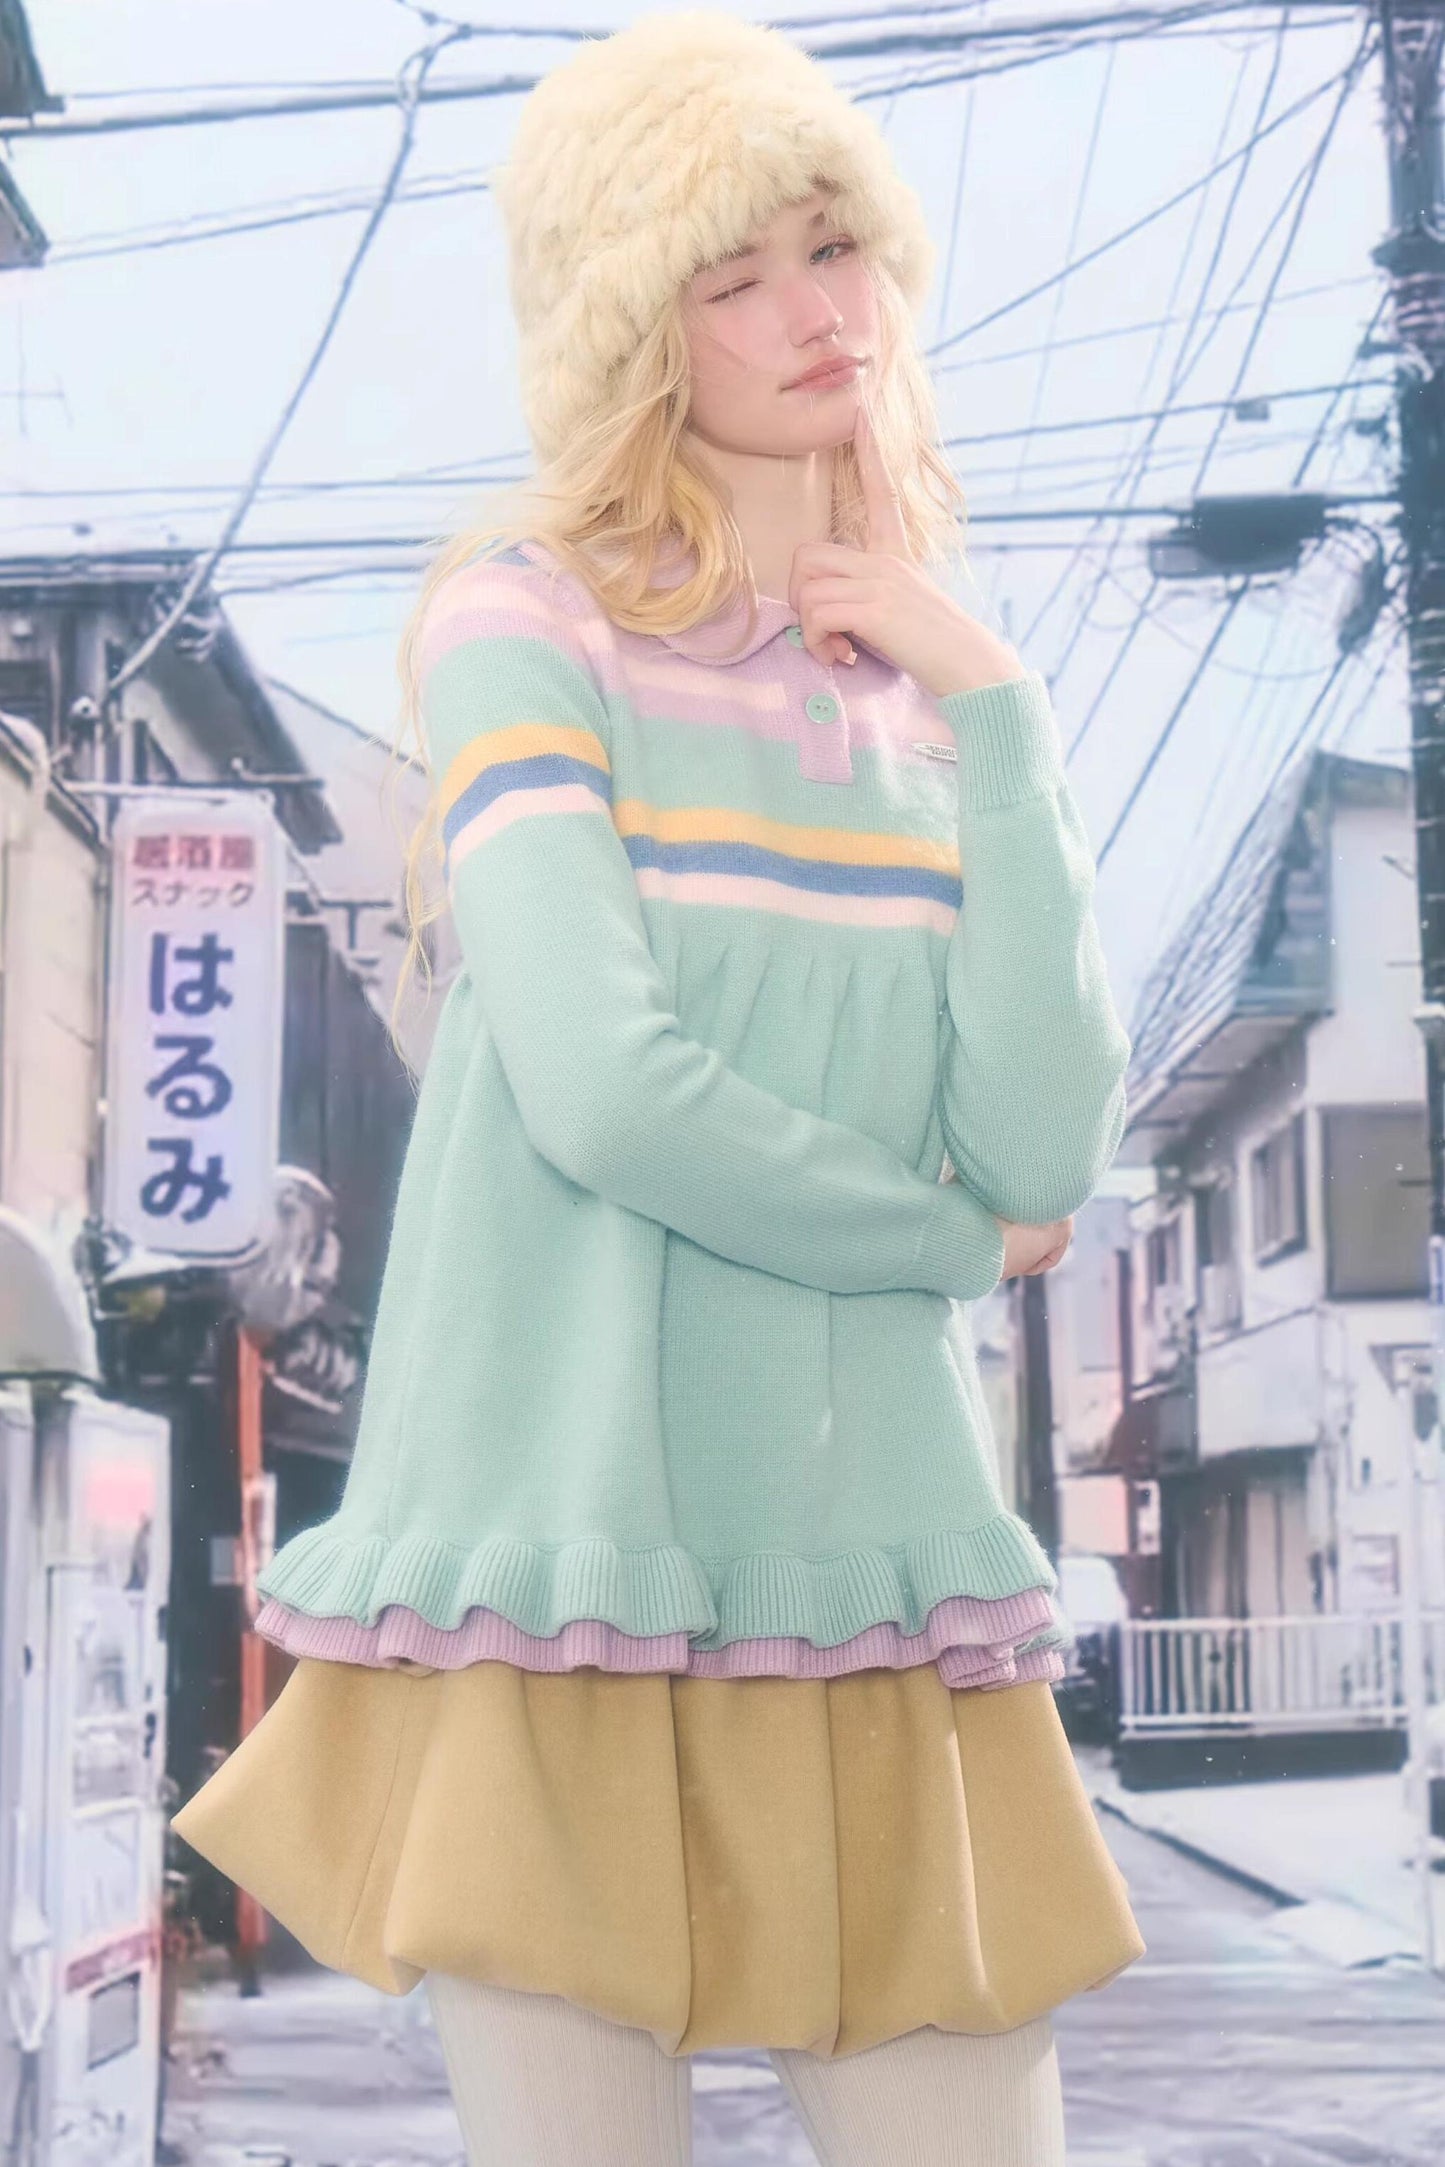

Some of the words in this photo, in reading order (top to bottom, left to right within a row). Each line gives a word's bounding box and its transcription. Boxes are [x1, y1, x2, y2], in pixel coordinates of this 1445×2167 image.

[132, 878, 254, 908] スナック
[140, 933, 234, 1224] はるみ
